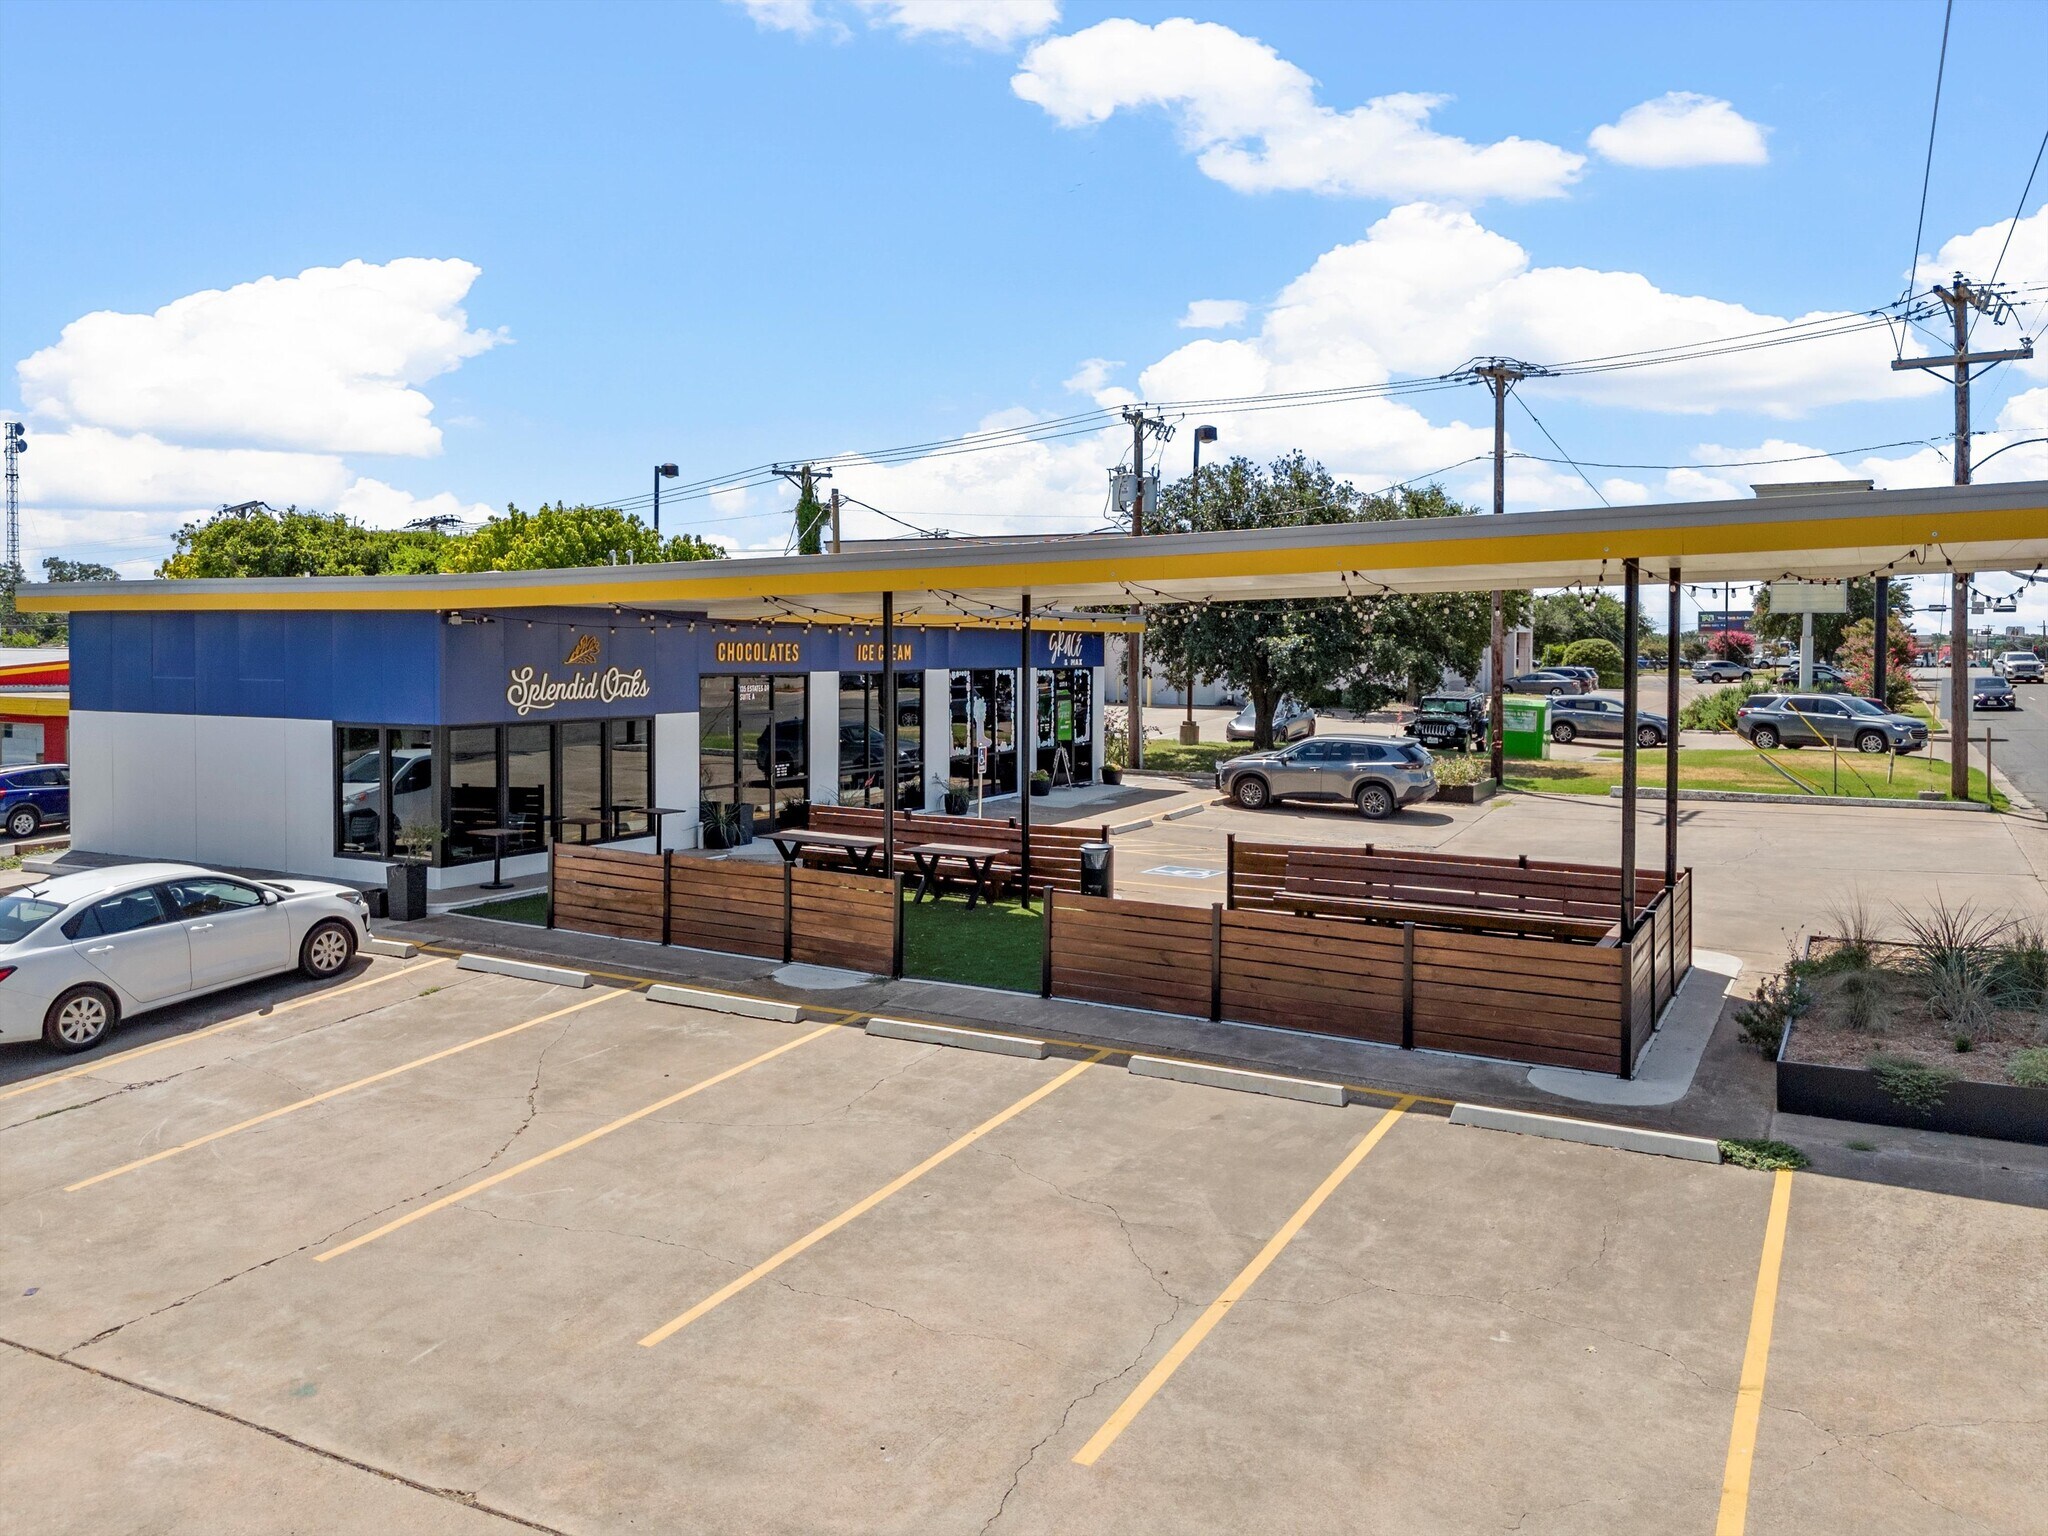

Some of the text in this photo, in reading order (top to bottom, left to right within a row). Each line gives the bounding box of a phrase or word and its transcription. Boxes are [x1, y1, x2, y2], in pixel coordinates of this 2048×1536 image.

[717, 642, 799, 662] CHOCOLATES
[857, 644, 912, 661] ICE CEAM
[1049, 631, 1082, 664] GRACE
[507, 667, 650, 716] Splendid Oaks
[747, 684, 764, 692] ESTATES
